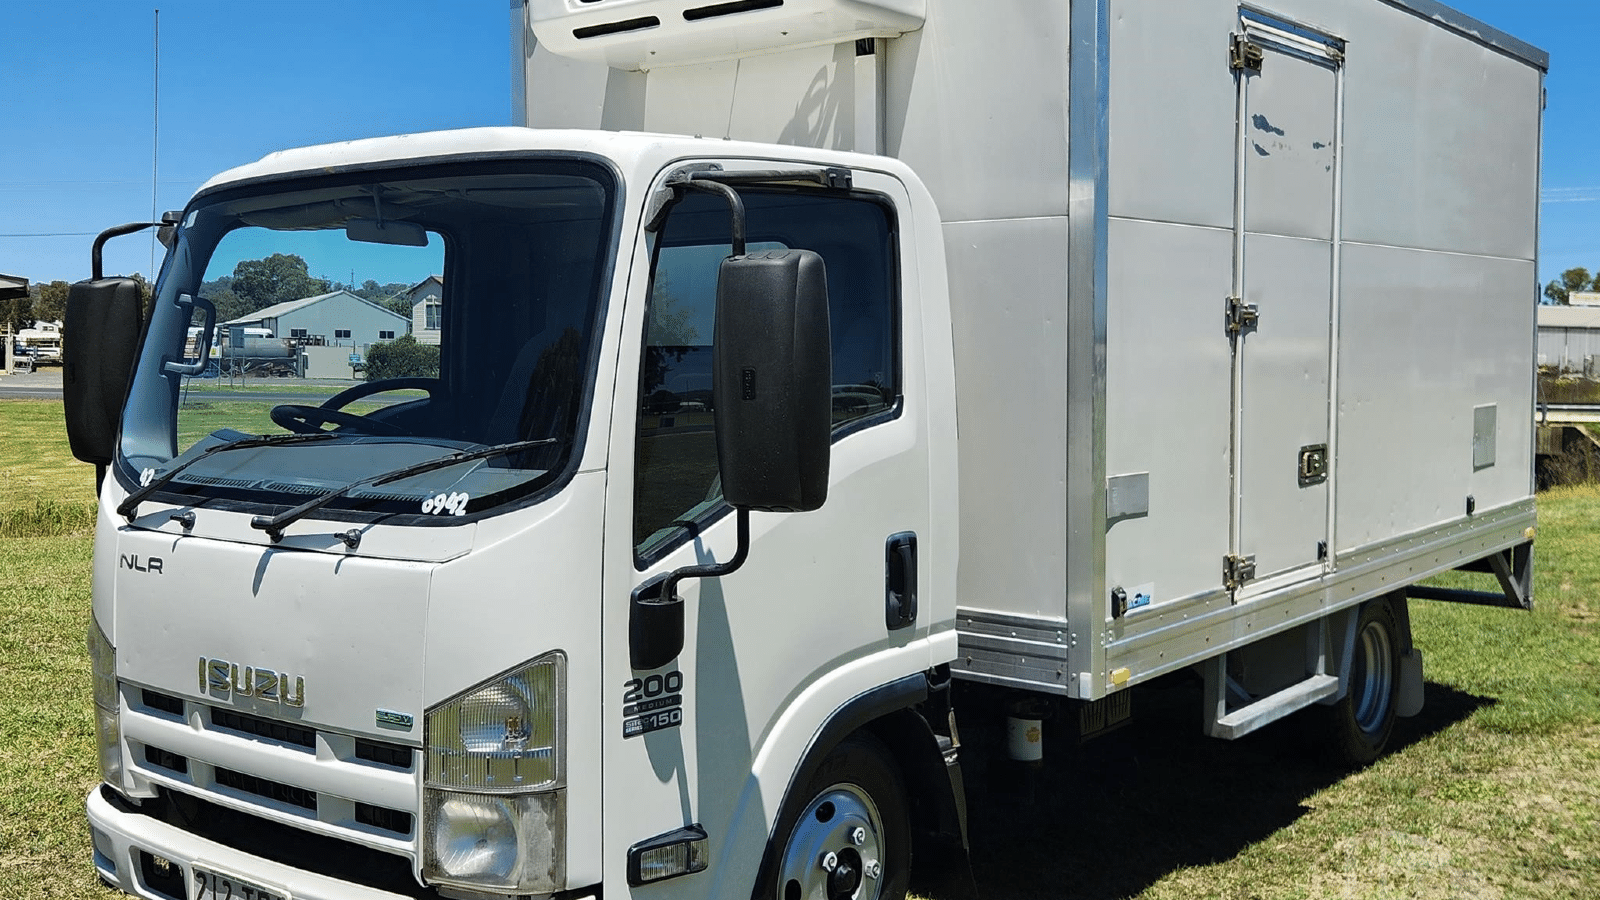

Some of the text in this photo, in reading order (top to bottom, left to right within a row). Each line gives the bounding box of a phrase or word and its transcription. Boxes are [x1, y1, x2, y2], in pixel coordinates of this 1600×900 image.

[120, 552, 163, 575] NLR
[198, 656, 306, 708] ISUZU
[623, 670, 684, 705] 200
[633, 698, 673, 712] MEDIUM
[650, 710, 681, 728] 150
